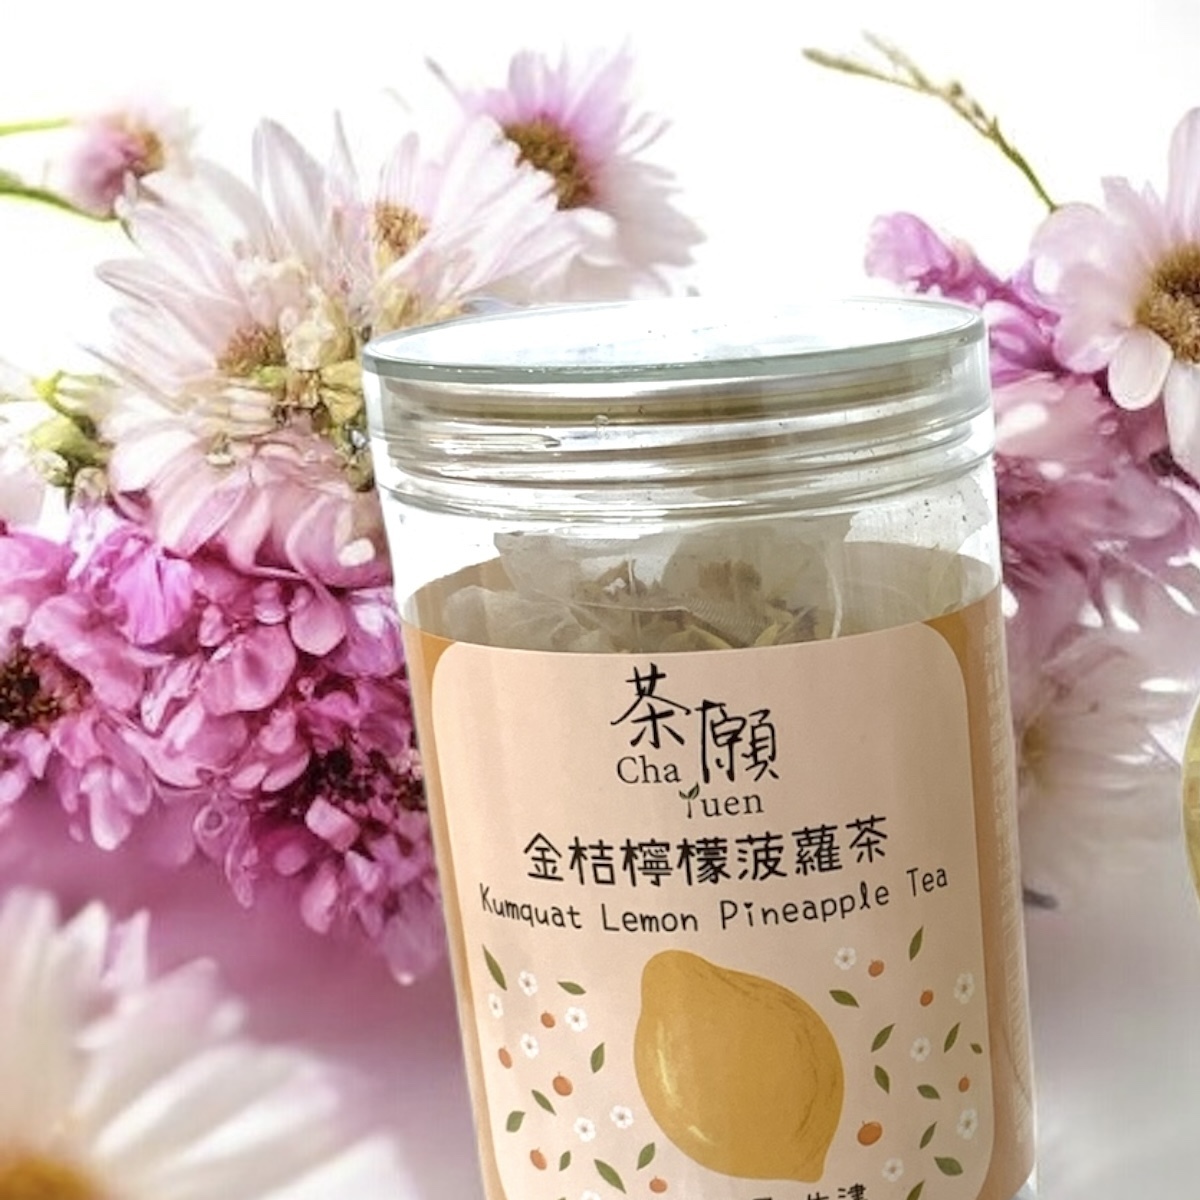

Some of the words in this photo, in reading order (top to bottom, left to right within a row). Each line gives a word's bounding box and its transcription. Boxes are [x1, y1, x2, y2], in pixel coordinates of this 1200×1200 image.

[616, 754, 682, 784] Cha
[679, 782, 765, 819] Yuen
[523, 815, 888, 888] 金桔檸檬菠蘿茶
[479, 882, 582, 930] Kumquat
[601, 903, 699, 933] Lemon
[720, 880, 891, 930] Pineapple
[907, 867, 949, 898] Tea
